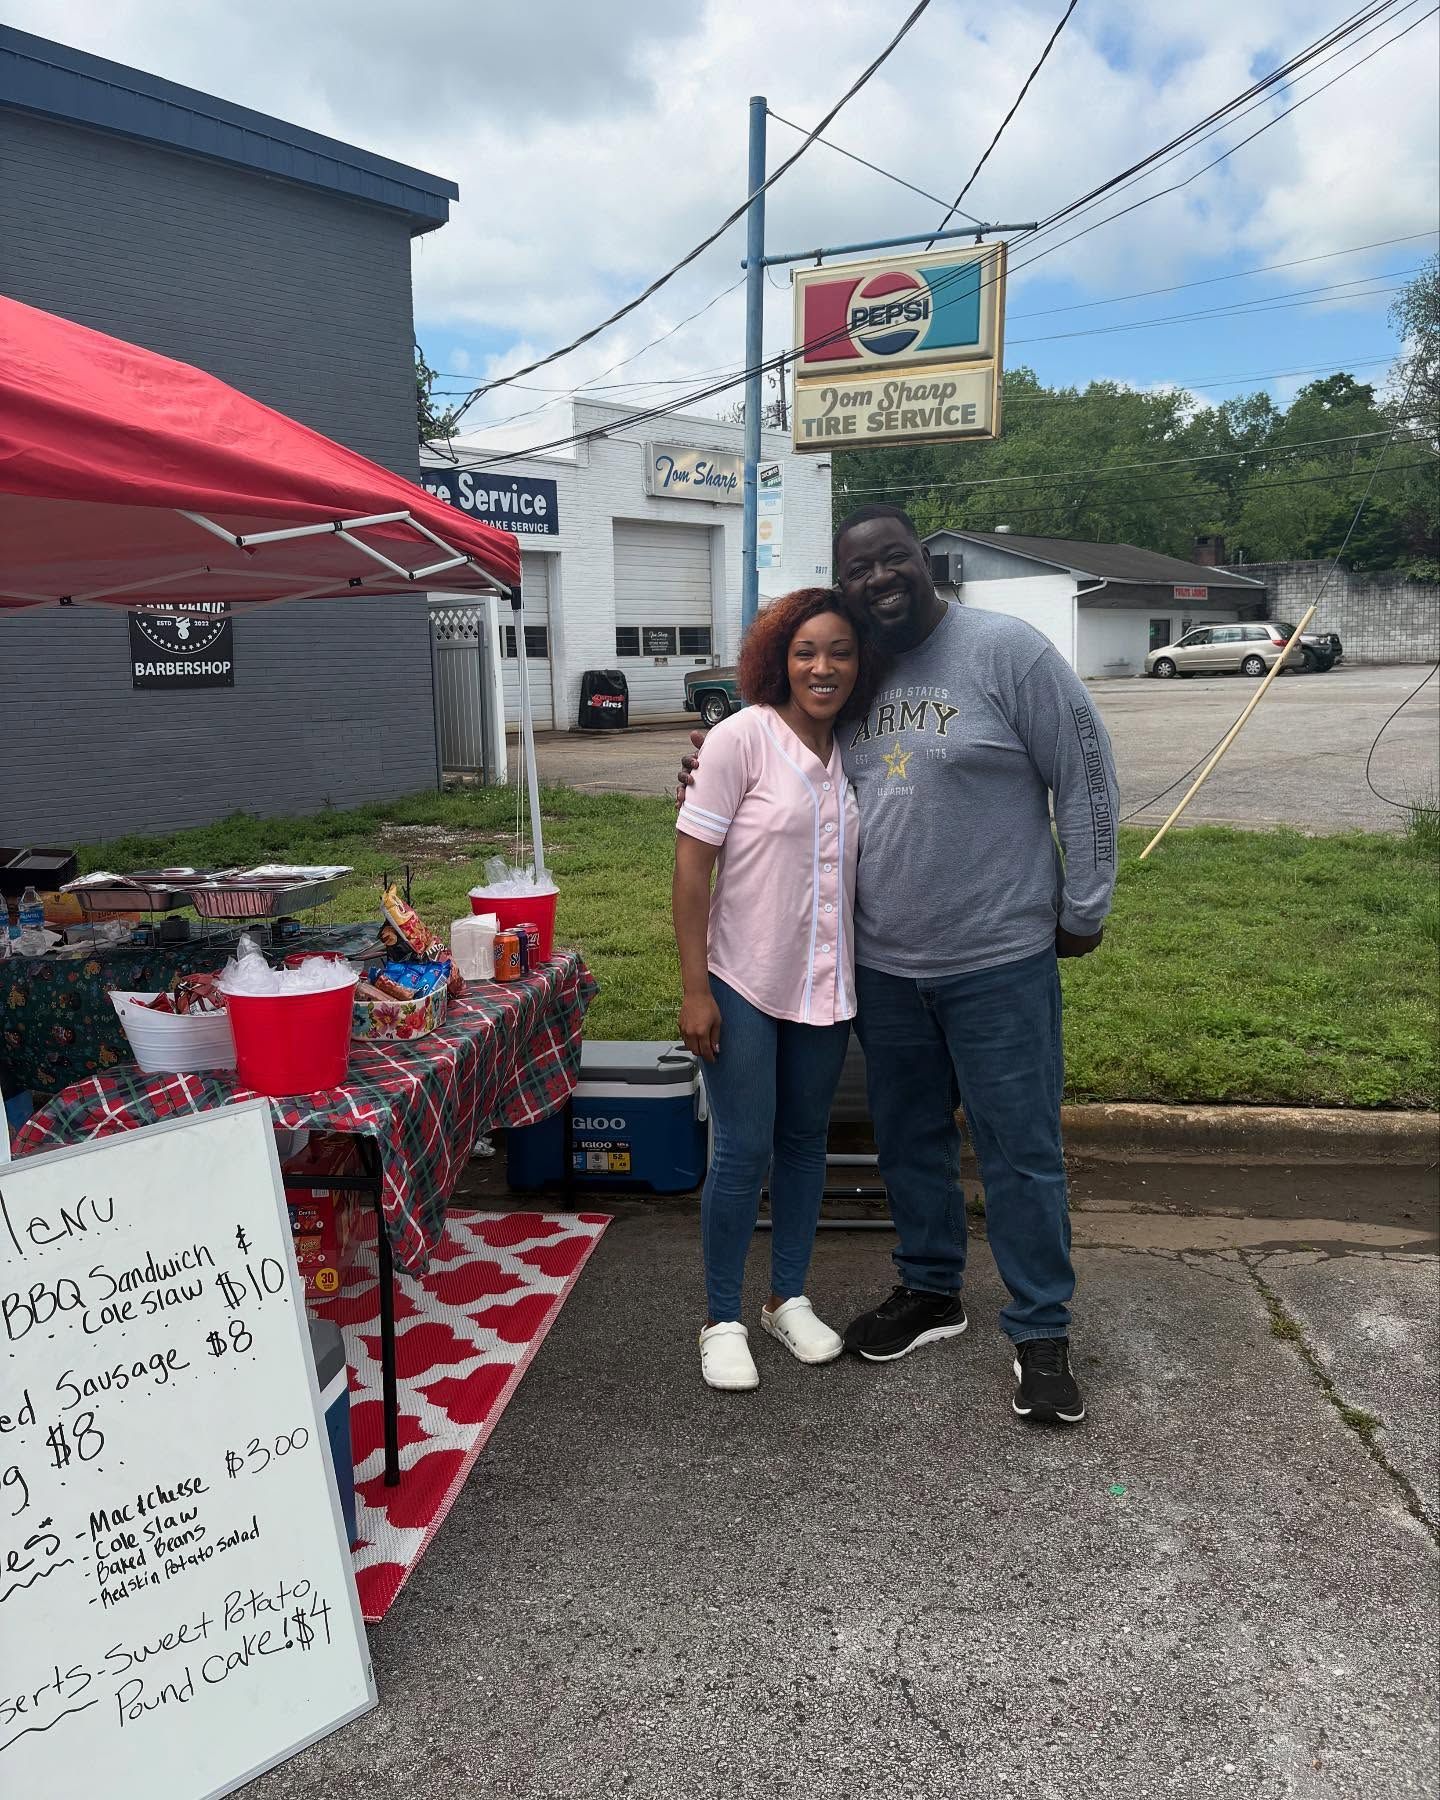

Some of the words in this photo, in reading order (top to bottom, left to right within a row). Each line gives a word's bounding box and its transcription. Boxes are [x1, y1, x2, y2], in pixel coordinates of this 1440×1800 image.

[851, 299, 929, 330] PEPSI
[820, 387, 873, 418] Tom
[877, 381, 957, 412] Sharp
[802, 414, 857, 438] TIRE
[866, 403, 977, 433] SERVICE
[458, 472, 547, 516] Service
[655, 455, 690, 487] Tom
[693, 461, 738, 495] Sharp
[511, 521, 549, 533] SERVICE
[134, 661, 231, 676] BARBERSHOP
[906, 686, 949, 699] STATES
[849, 699, 960, 751] ARMY
[1074, 705, 1096, 743] DUTY
[926, 748, 947, 760] 1775
[1084, 750, 1106, 794] HONOR
[1094, 802, 1113, 864] COUNTRY
[581, 1141, 613, 1149] IGLOO
[2, 1279, 87, 1341] BBQ
[89, 1244, 216, 1301] Sandwich
[215, 1258, 285, 1310] $10
[320, 1271, 334, 1284] 30
[56, 1349, 191, 1410] Sausage
[205, 1319, 253, 1357] $8
[45, 1411, 105, 1469] $8
[225, 1427, 309, 1478] $3.00
[154, 1524, 206, 1558] Beans
[165, 1545, 214, 1579] Potato
[224, 1579, 311, 1631] Potato
[114, 1667, 194, 1728] Pound
